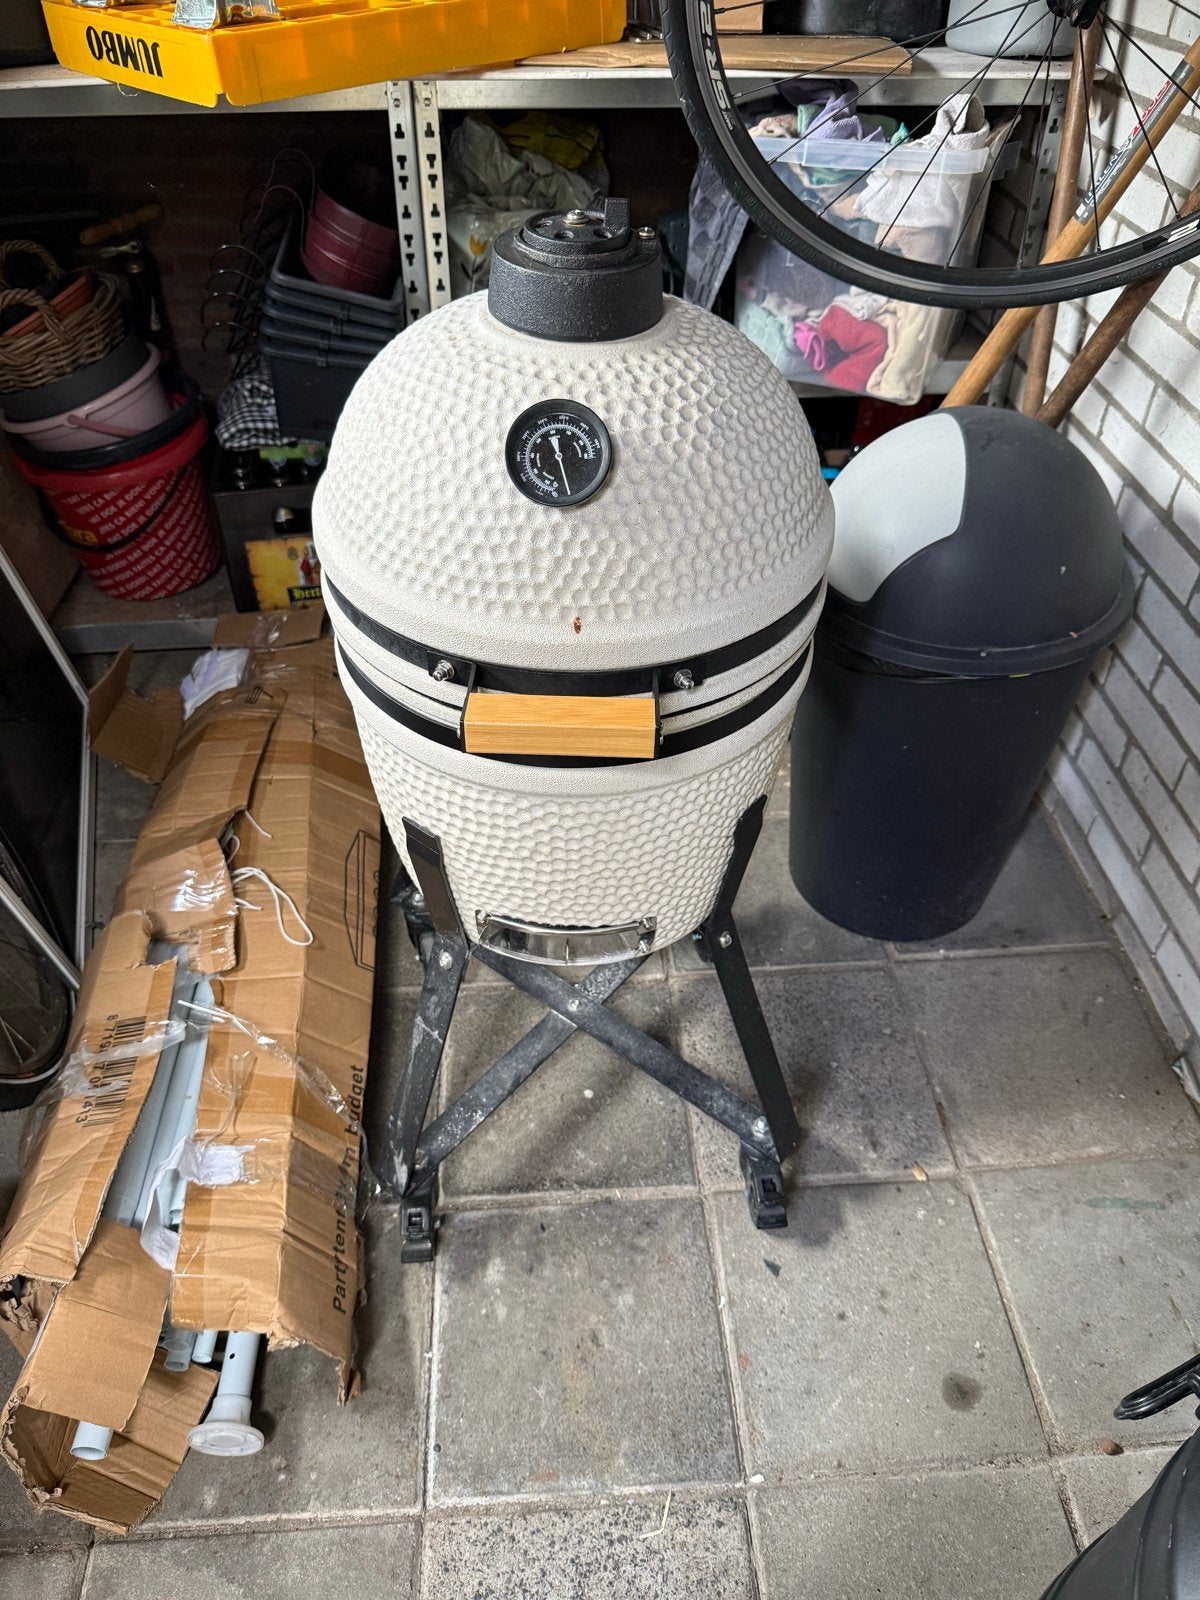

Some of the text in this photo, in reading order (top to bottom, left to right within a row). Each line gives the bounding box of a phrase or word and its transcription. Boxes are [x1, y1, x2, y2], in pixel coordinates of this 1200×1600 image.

[86, 25, 163, 78] JUMBO
[700, 0, 731, 110] SR-2
[332, 1207, 349, 1315] Partytent
[344, 1064, 365, 1137] budget
